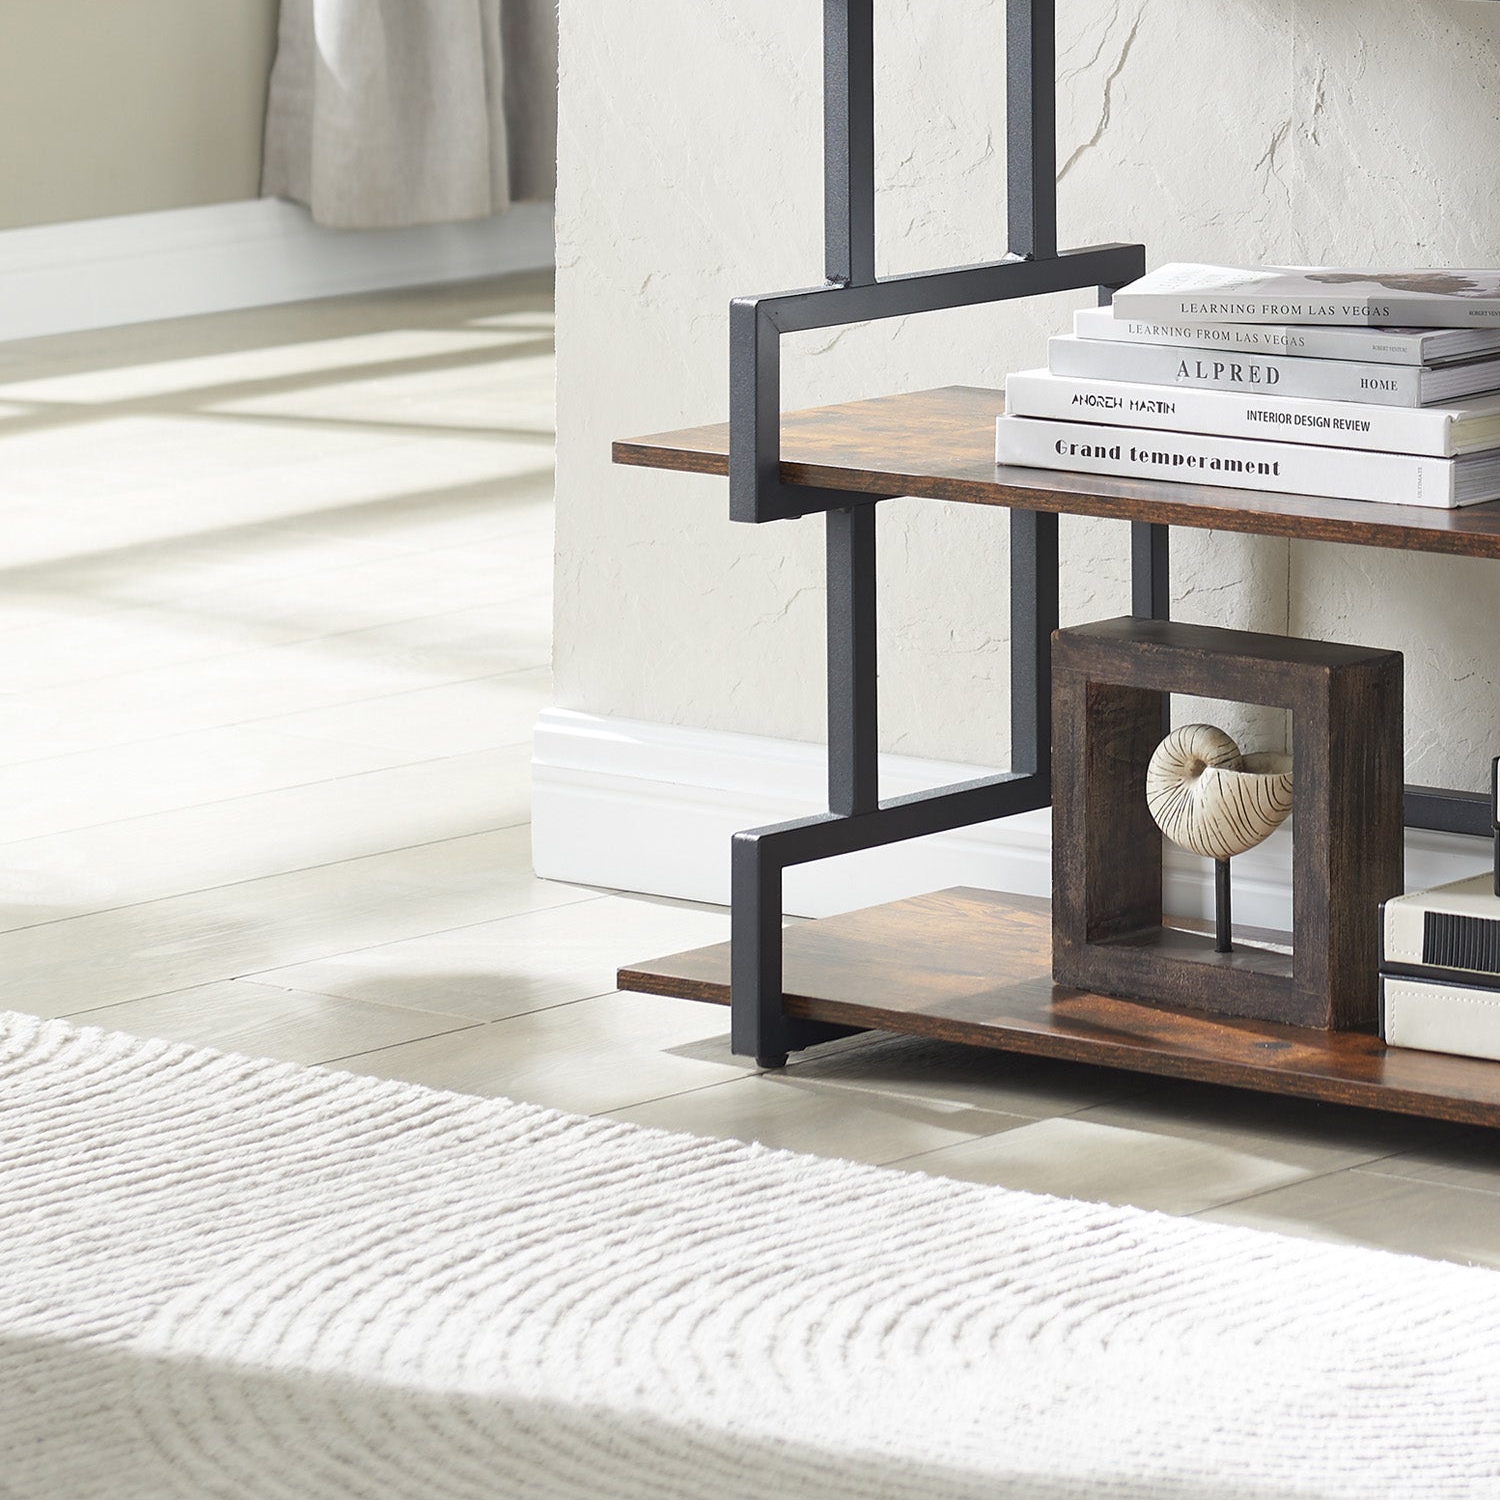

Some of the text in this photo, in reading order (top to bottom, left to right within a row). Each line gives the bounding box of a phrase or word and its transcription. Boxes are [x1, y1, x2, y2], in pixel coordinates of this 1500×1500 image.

[1181, 303, 1390, 317] LEARNING FROM LAS VEGAS
[1128, 324, 1305, 347] LEARNING FROM LAS VEGAS
[1177, 360, 1398, 391] ALPRED HOME
[1130, 400, 1176, 414] MARTIN
[1246, 409, 1371, 432] INTERIOR DESIGN REVIEW
[1055, 439, 1281, 476] Grand temperament
